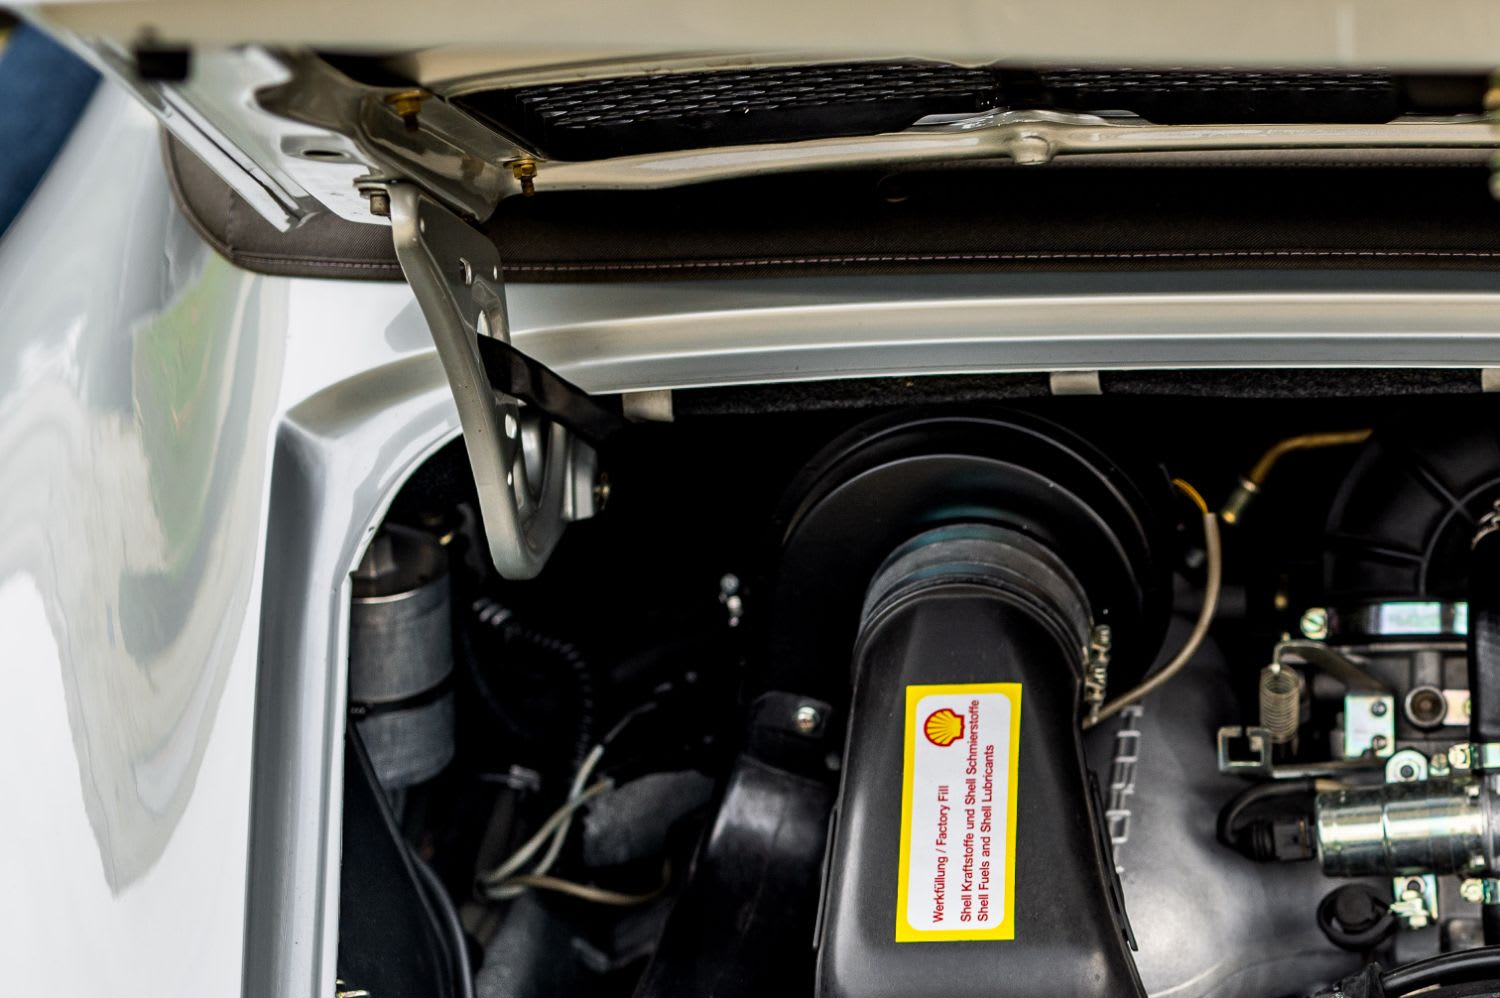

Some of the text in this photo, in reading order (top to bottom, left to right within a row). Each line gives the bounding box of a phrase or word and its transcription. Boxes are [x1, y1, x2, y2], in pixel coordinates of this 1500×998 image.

[936, 805, 950, 846] Factory
[938, 785, 949, 802] Fill
[961, 700, 980, 922] Shell Kraftstoffe und Shell Schmierstoffe
[977, 744, 994, 922] Shell Fuels and Shell Lubricants
[933, 856, 949, 923] Werkfüllung
